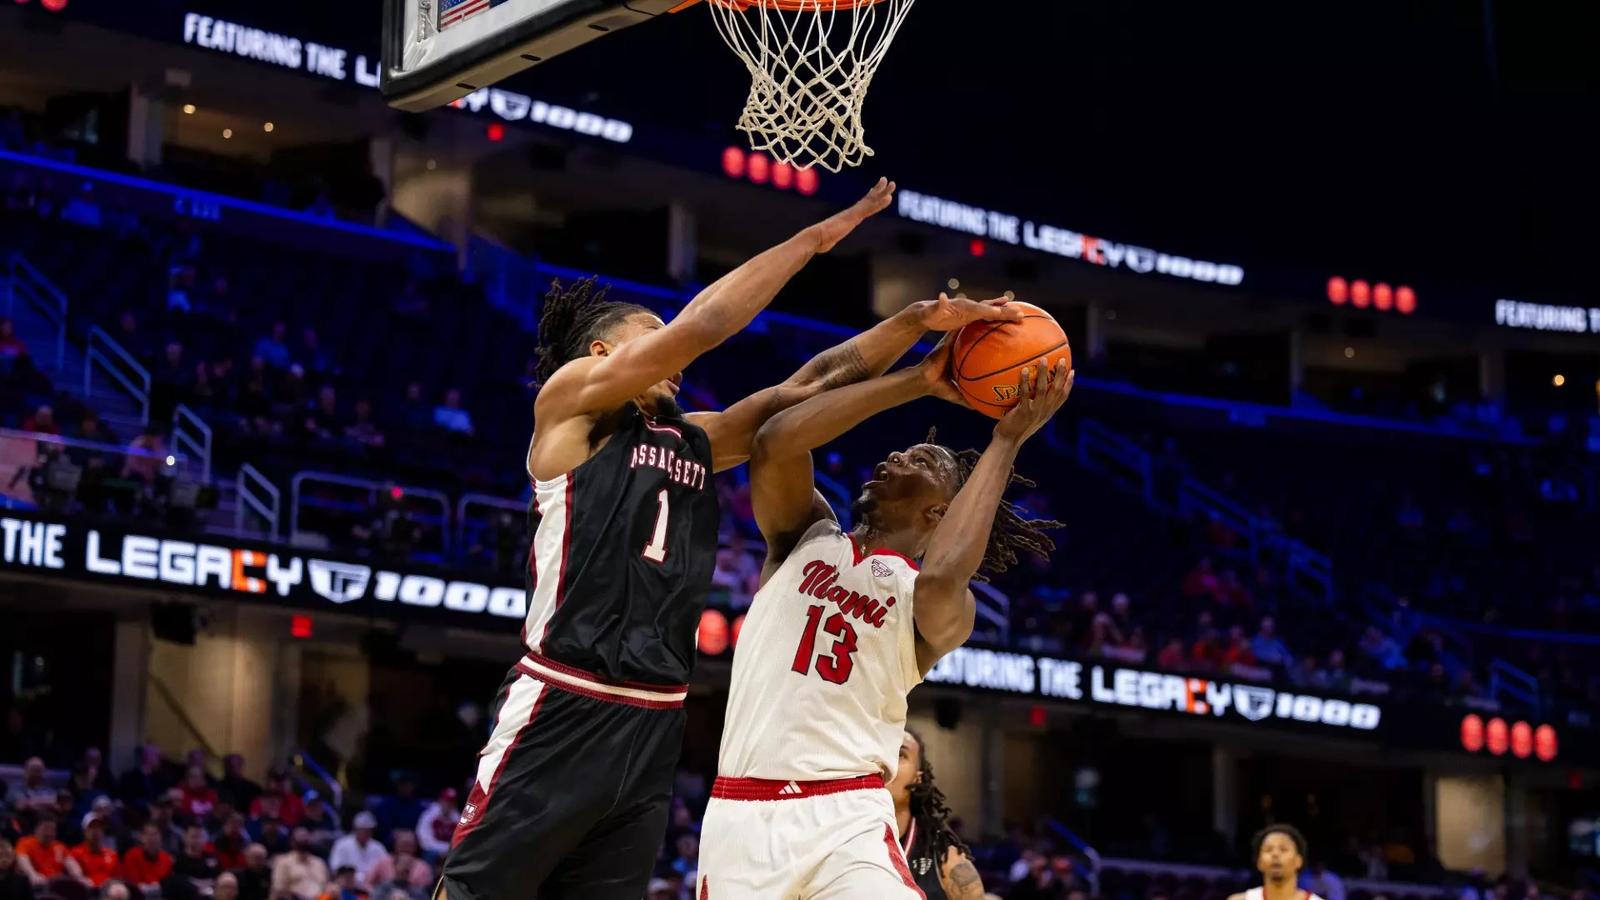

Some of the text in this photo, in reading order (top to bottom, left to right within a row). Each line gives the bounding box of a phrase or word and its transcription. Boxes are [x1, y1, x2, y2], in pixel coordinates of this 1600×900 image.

[184, 12, 301, 68] FEATURING
[305, 43, 347, 79] THE
[899, 190, 986, 236] FEATURING
[987, 211, 1020, 245] THE
[1495, 299, 1587, 333] FEATURING
[643, 488, 669, 563] 1
[0, 517, 526, 619] THE LEGACY 1000
[799, 559, 896, 628] Miami
[791, 604, 858, 685] 13
[1036, 657, 1083, 700] THE
[1092, 665, 1231, 717] LEGACY
[1275, 692, 1381, 730] 1000
